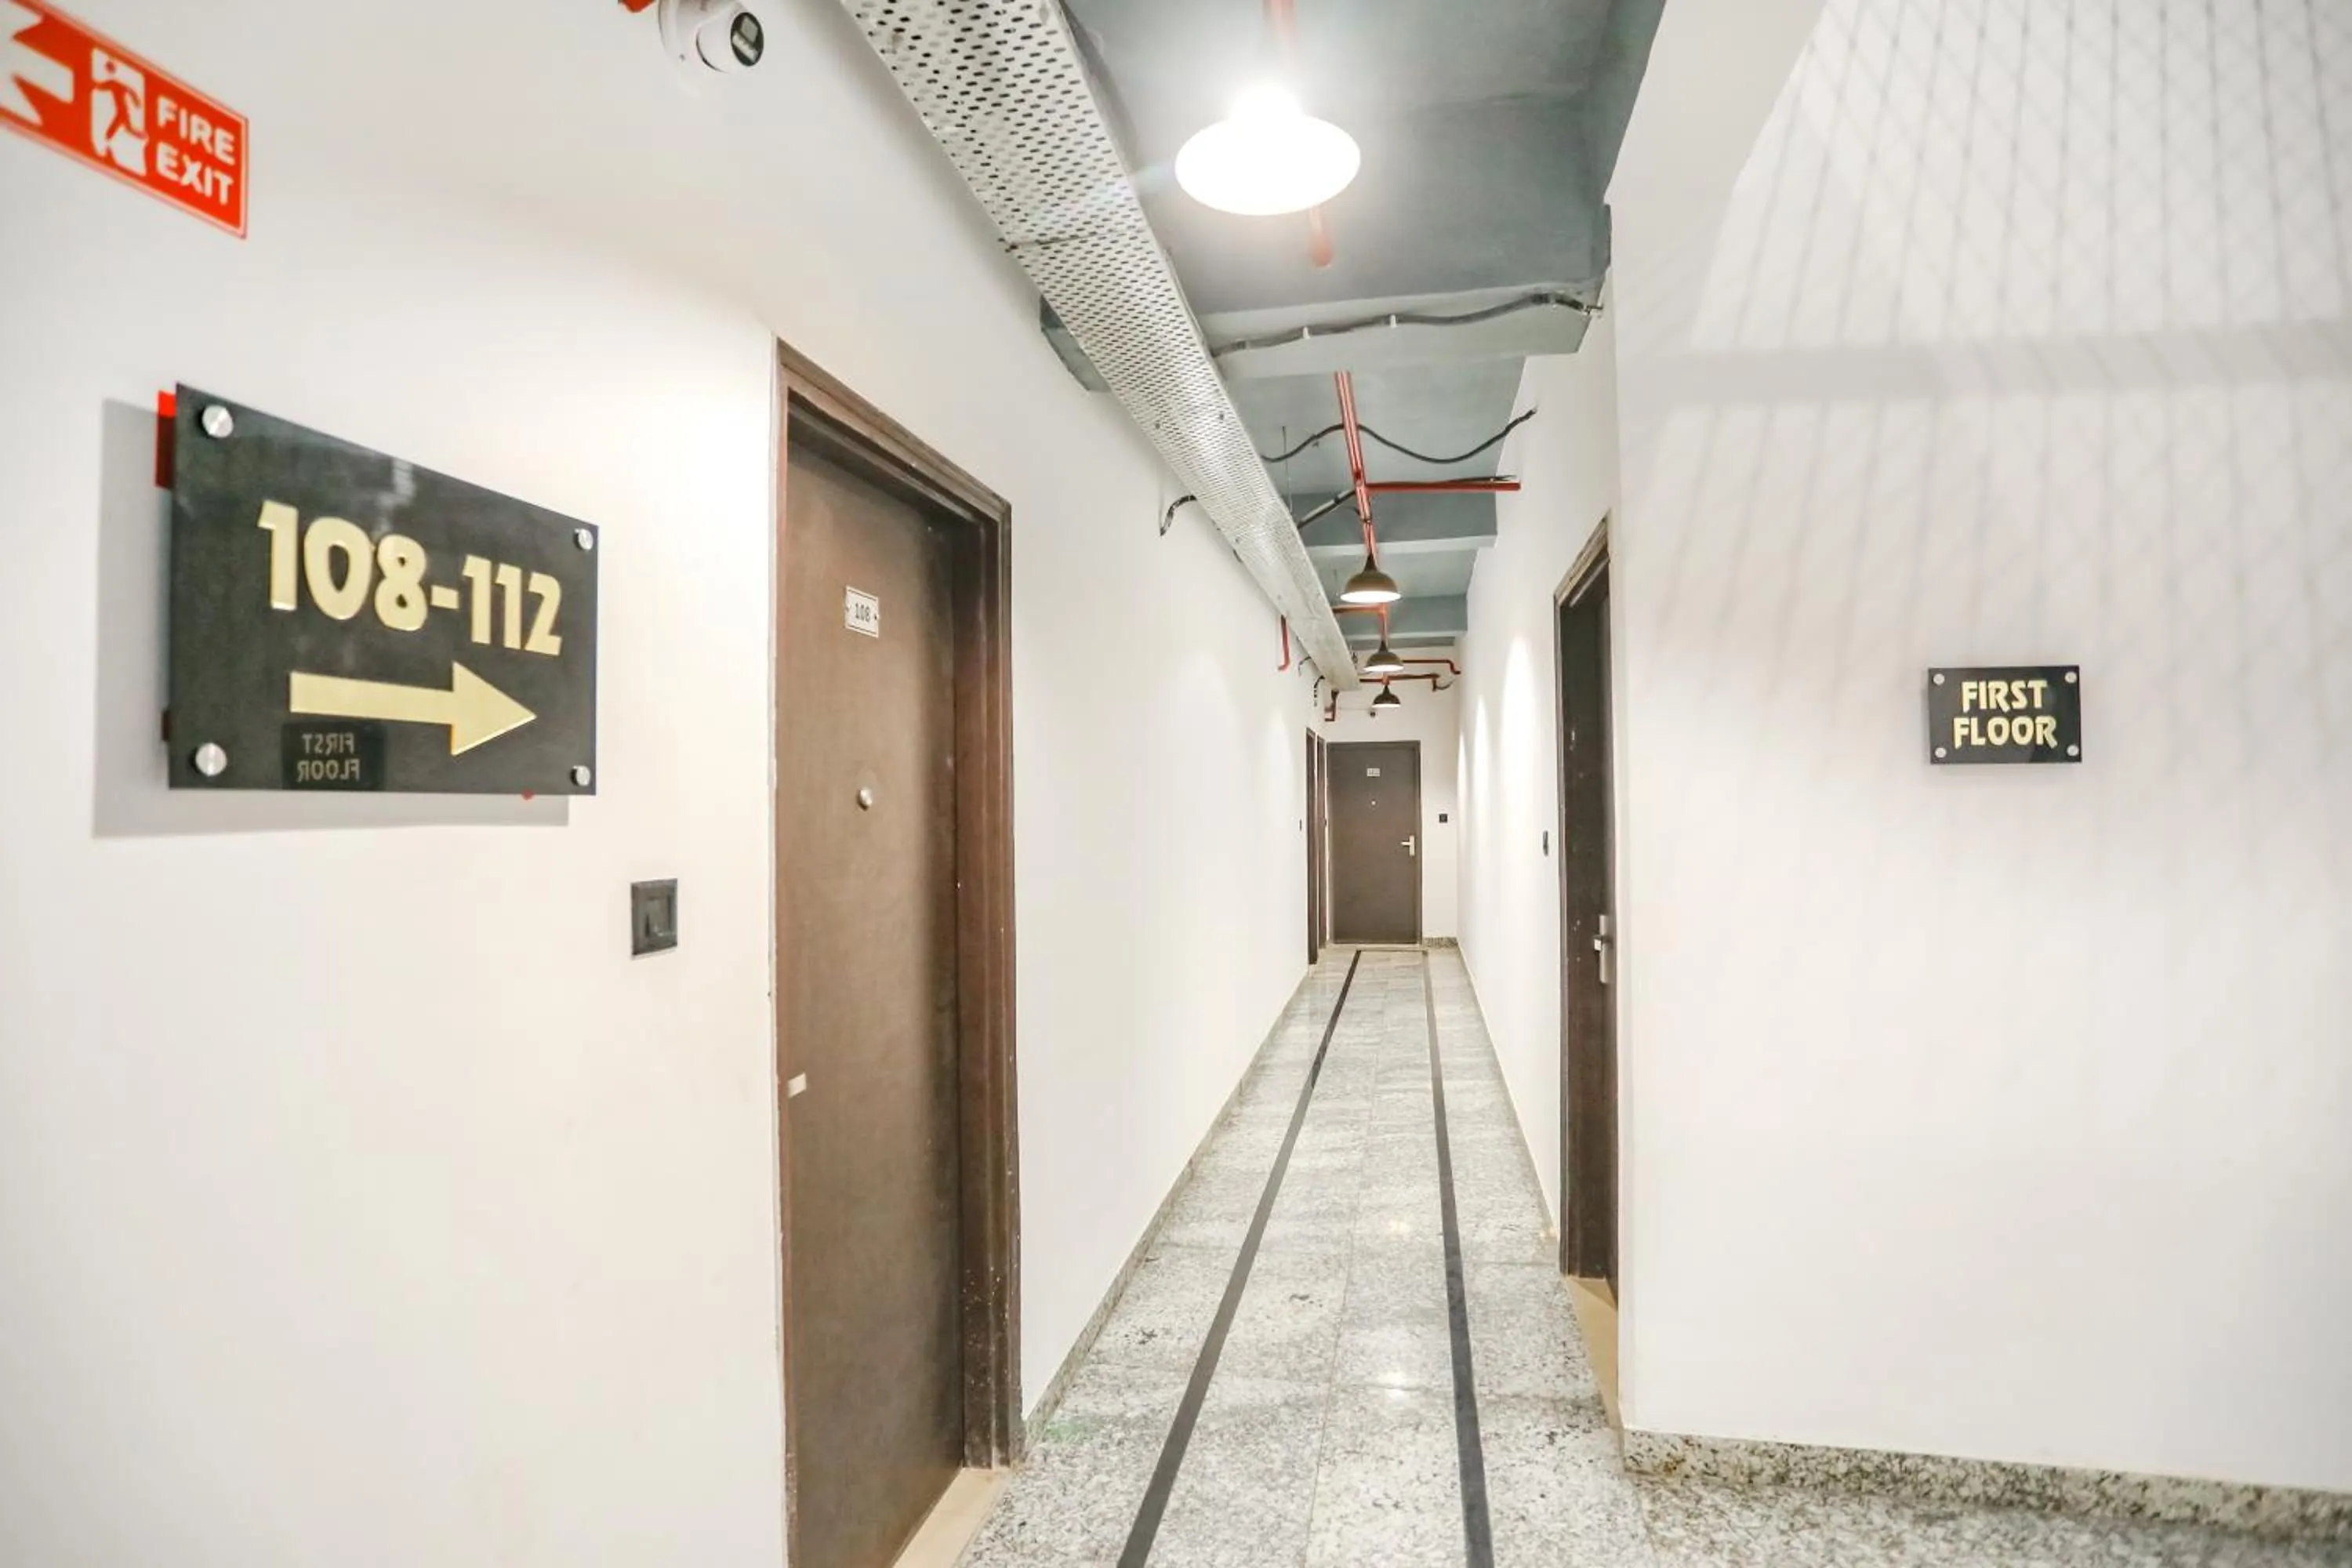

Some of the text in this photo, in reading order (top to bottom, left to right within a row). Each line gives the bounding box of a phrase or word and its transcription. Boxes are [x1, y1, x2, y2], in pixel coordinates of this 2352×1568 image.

[157, 95, 235, 166] FIRE
[157, 141, 234, 205] EXIT
[256, 499, 562, 656] 108-112
[1961, 679, 2049, 713] FIRST
[1953, 715, 2058, 750] FLOOR
